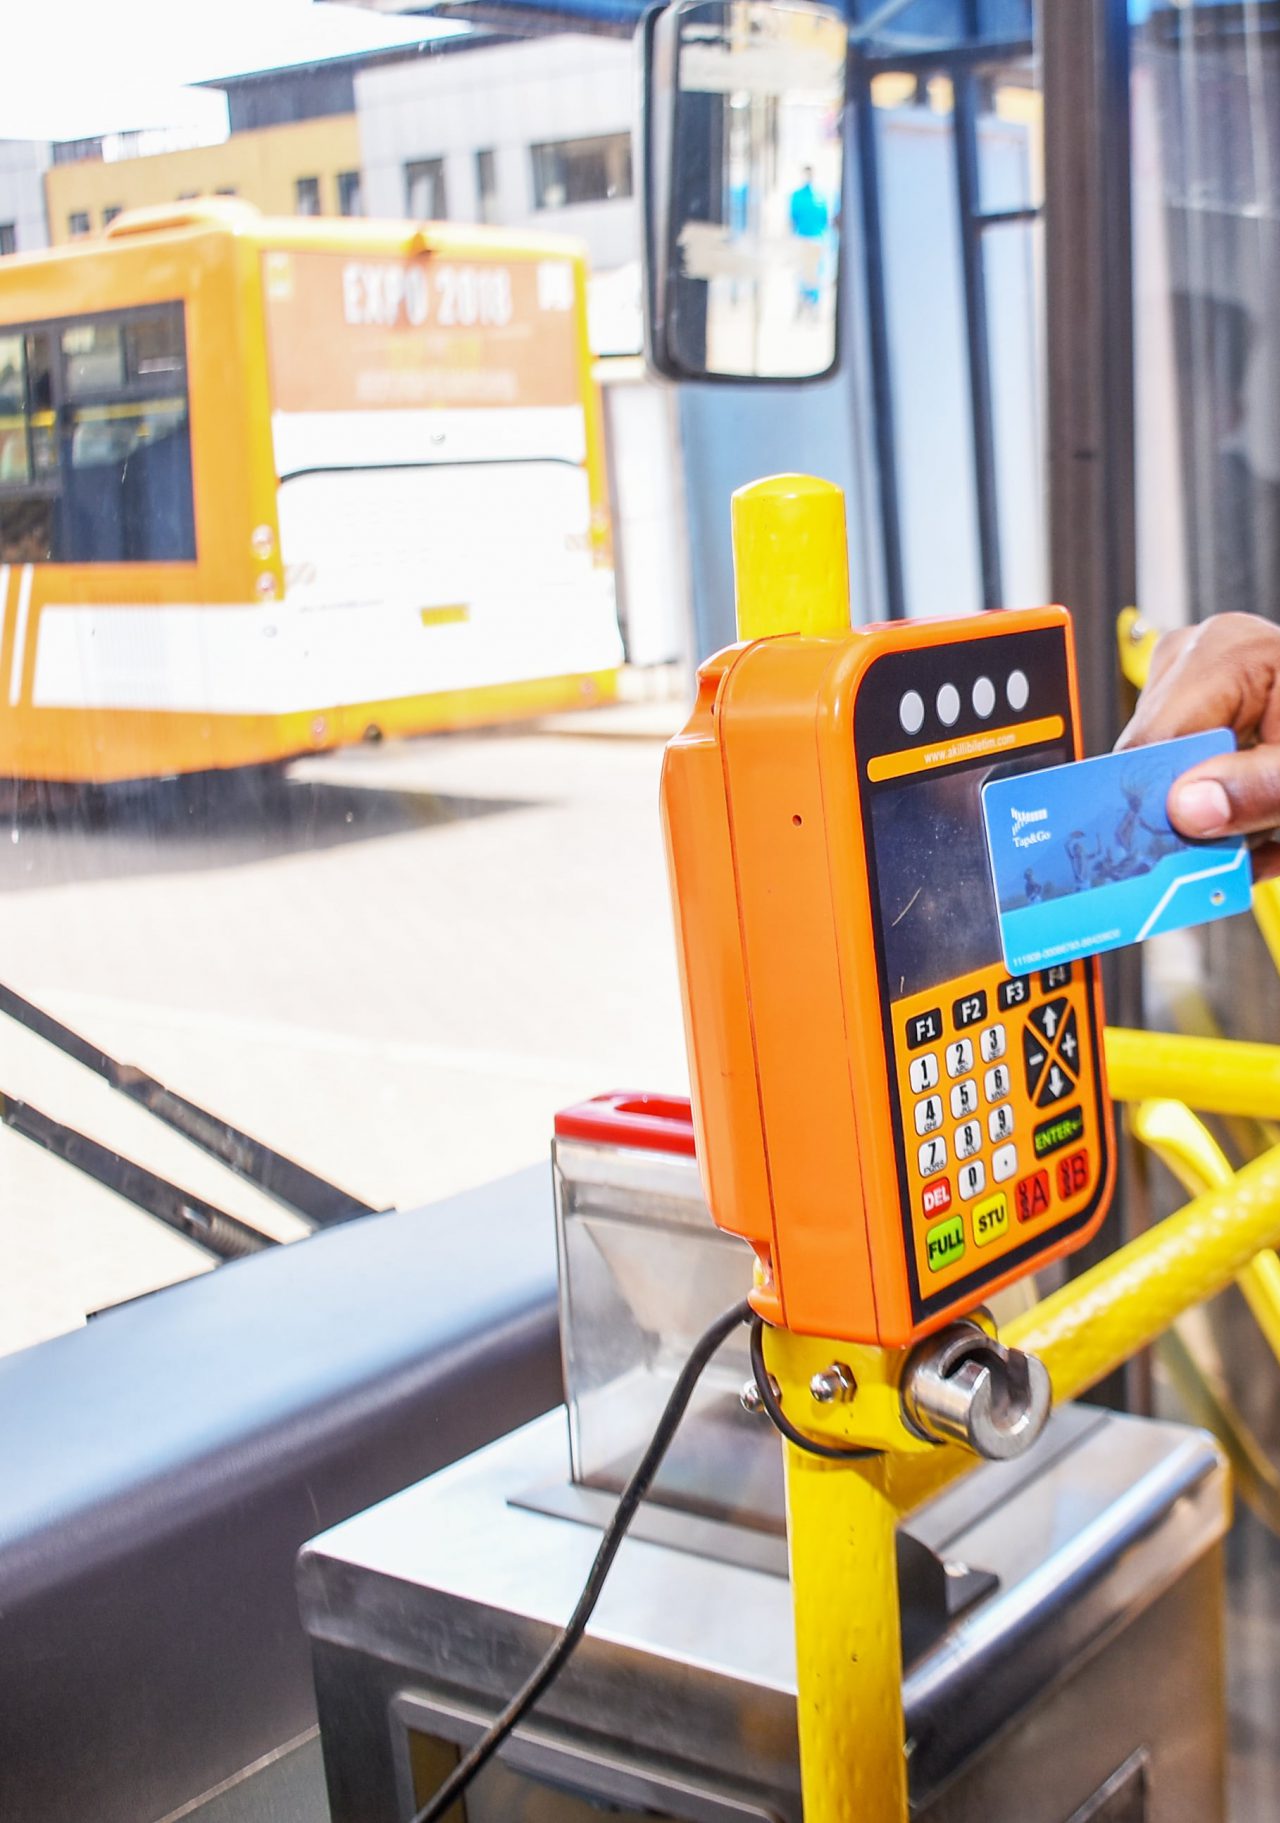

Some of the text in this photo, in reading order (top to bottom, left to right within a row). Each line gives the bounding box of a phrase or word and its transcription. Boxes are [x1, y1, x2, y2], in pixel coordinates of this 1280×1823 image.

[344, 264, 427, 325] EXPO
[437, 266, 512, 326] 2018
[924, 733, 1016, 765] www.akillibiletim.com
[1012, 830, 1052, 849] Tap&Go
[916, 965, 1066, 1042] F1 F2 F3 F4
[921, 1029, 998, 1080] 1 2 3
[926, 1069, 1002, 1121] 4 5 6
[928, 1141, 936, 1166] 7
[964, 1125, 973, 1146] 8
[998, 1109, 1006, 1130] 9
[1034, 1120, 1074, 1152] ENTER
[923, 1166, 977, 1212] DEL 0
[928, 1229, 964, 1260] FULL
[978, 1205, 1005, 1233] STU
[1032, 1176, 1049, 1214] A
[1072, 1156, 1087, 1192] B
